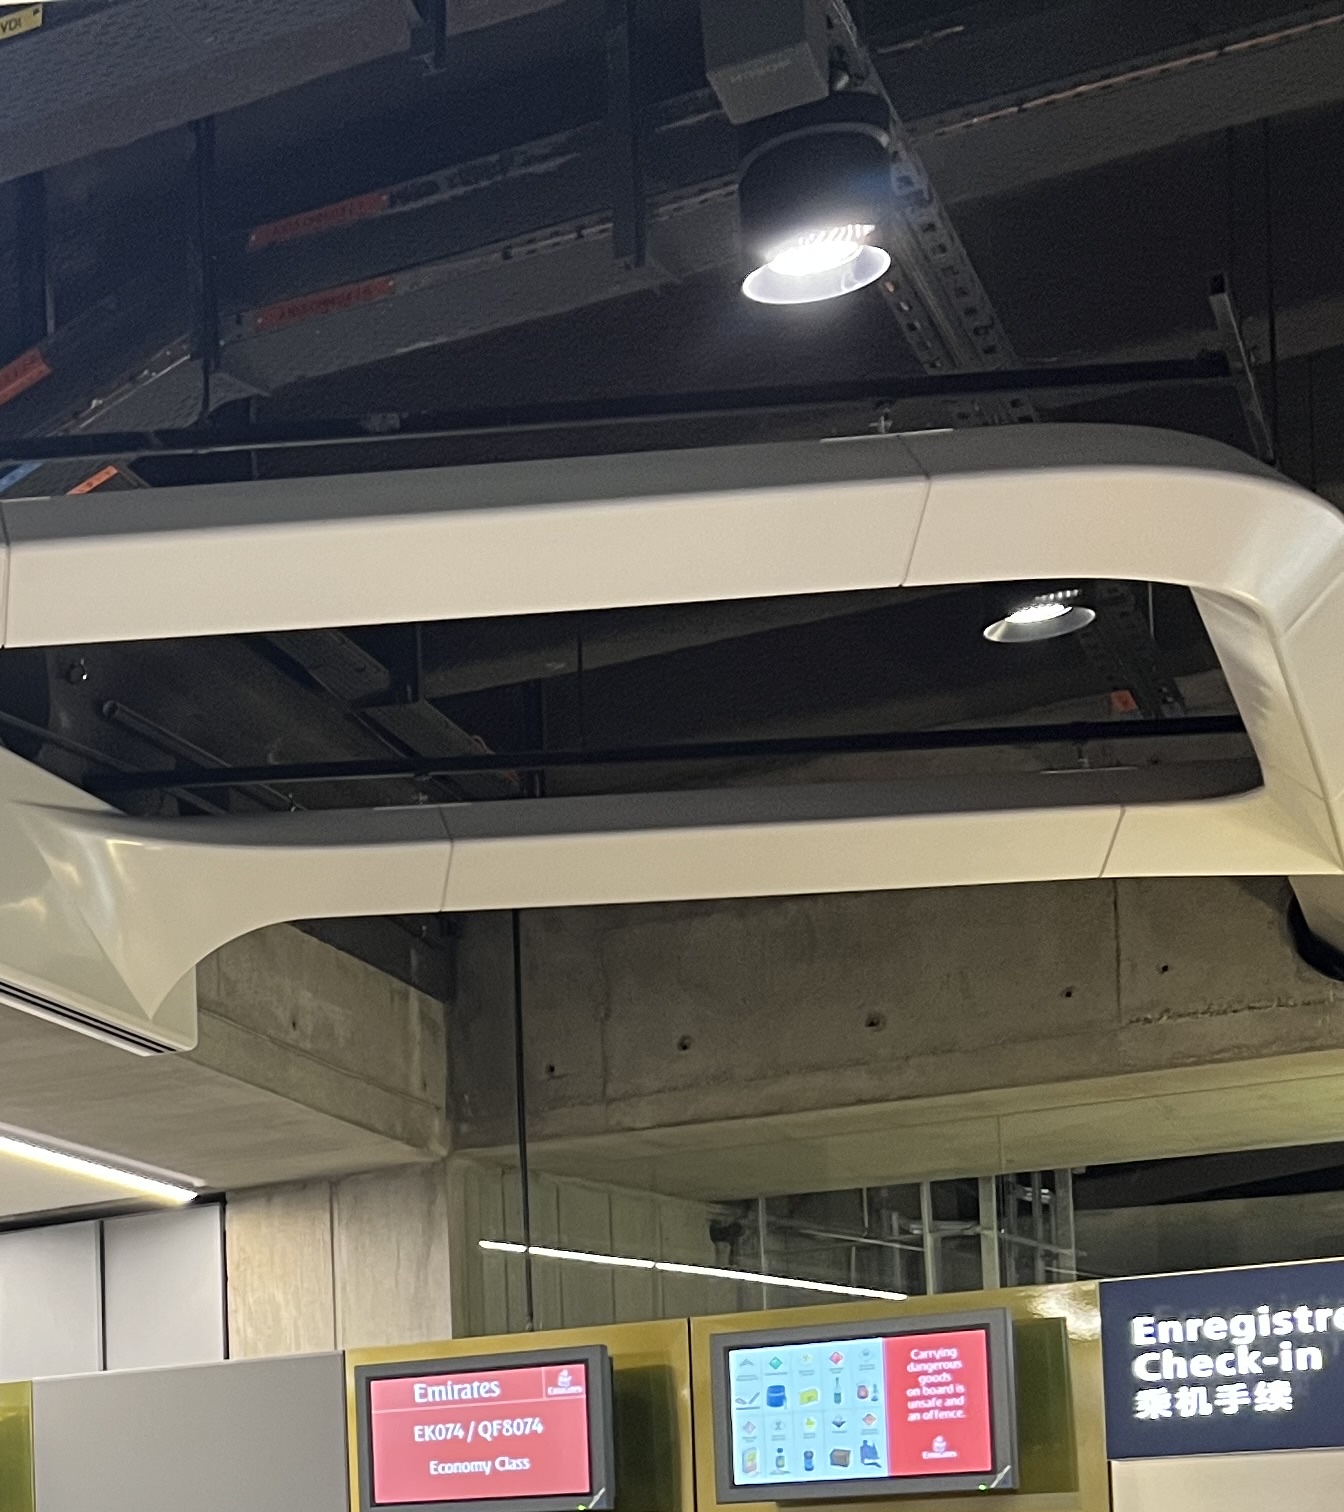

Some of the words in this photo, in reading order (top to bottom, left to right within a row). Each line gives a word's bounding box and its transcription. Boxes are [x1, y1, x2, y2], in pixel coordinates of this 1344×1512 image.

[910, 1347, 958, 1362] Carrying
[1132, 1340, 1323, 1382] Check-in
[906, 1359, 963, 1374] dangerous
[918, 1372, 952, 1386] goods
[413, 1380, 500, 1403] Emirates
[922, 1384, 954, 1397] board
[907, 1396, 942, 1409] unsafe
[944, 1395, 965, 1407] and
[907, 1411, 921, 1421] an
[414, 1423, 464, 1442] EK074
[477, 1417, 544, 1442] QF8074
[429, 1459, 492, 1475] Economy
[494, 1457, 531, 1471] Class
